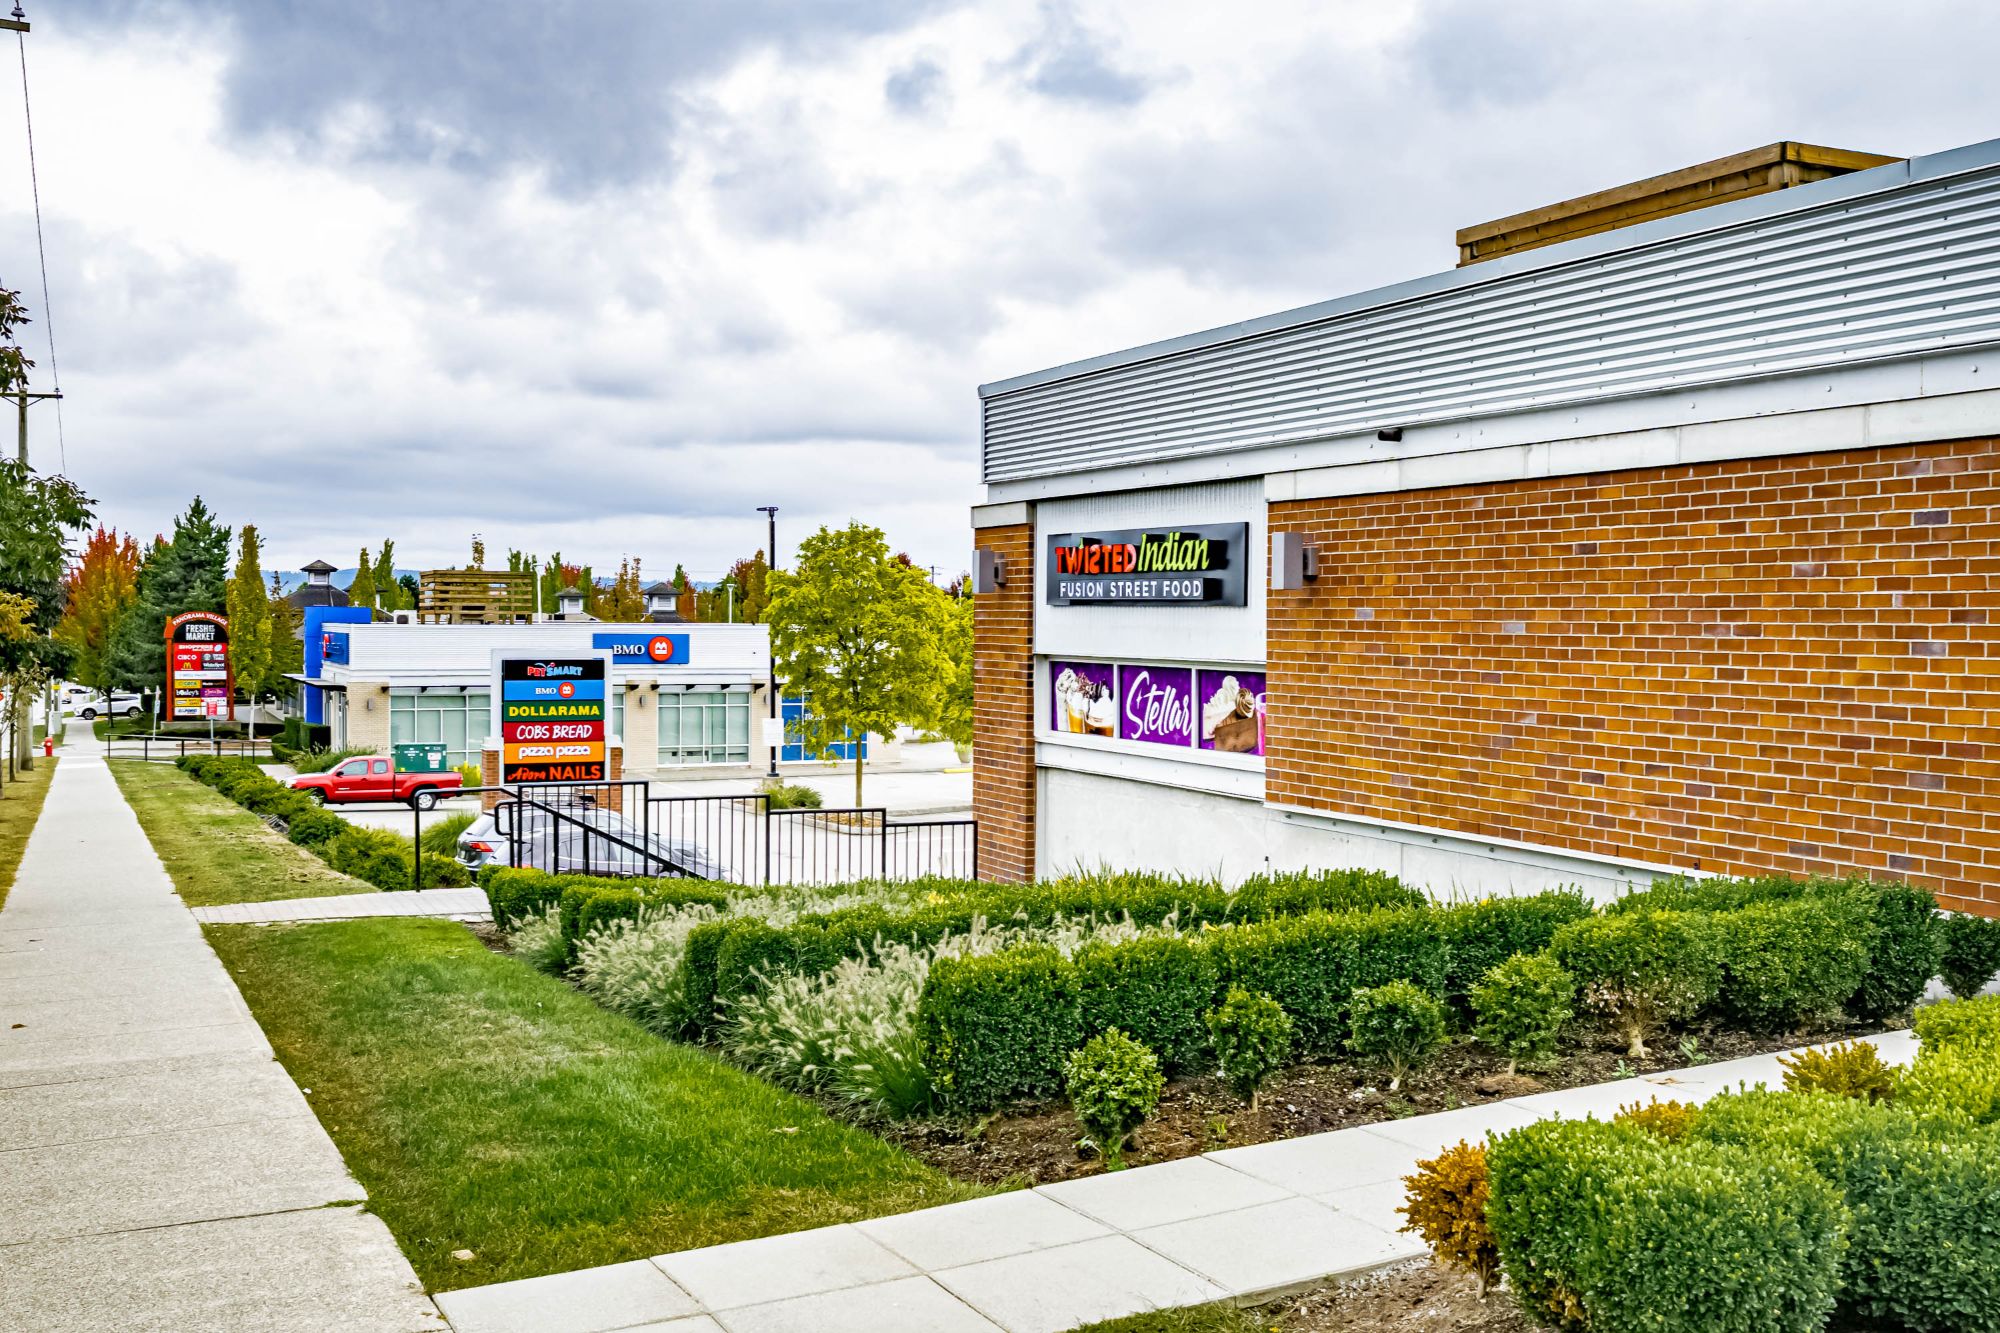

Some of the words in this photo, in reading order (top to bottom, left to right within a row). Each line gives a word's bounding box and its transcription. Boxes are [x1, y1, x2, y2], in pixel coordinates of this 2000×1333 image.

[1137, 532, 1210, 572] Indian
[1060, 582, 1104, 597] FUSION
[1110, 581, 1156, 597] STREET
[1163, 580, 1202, 596] FOOD
[172, 612, 205, 626] PANORAMA
[185, 632, 215, 641] MARKET
[613, 644, 645, 655] BMO
[527, 663, 583, 677] PETSMART
[509, 705, 600, 717] DOLLARAMA
[1126, 670, 1193, 739] Stellar
[516, 725, 550, 740] COBS
[552, 724, 593, 739] BREAD
[518, 746, 554, 760] pizza
[556, 745, 591, 759] pizza
[507, 767, 547, 781] Adora
[549, 765, 601, 780] NAILS
